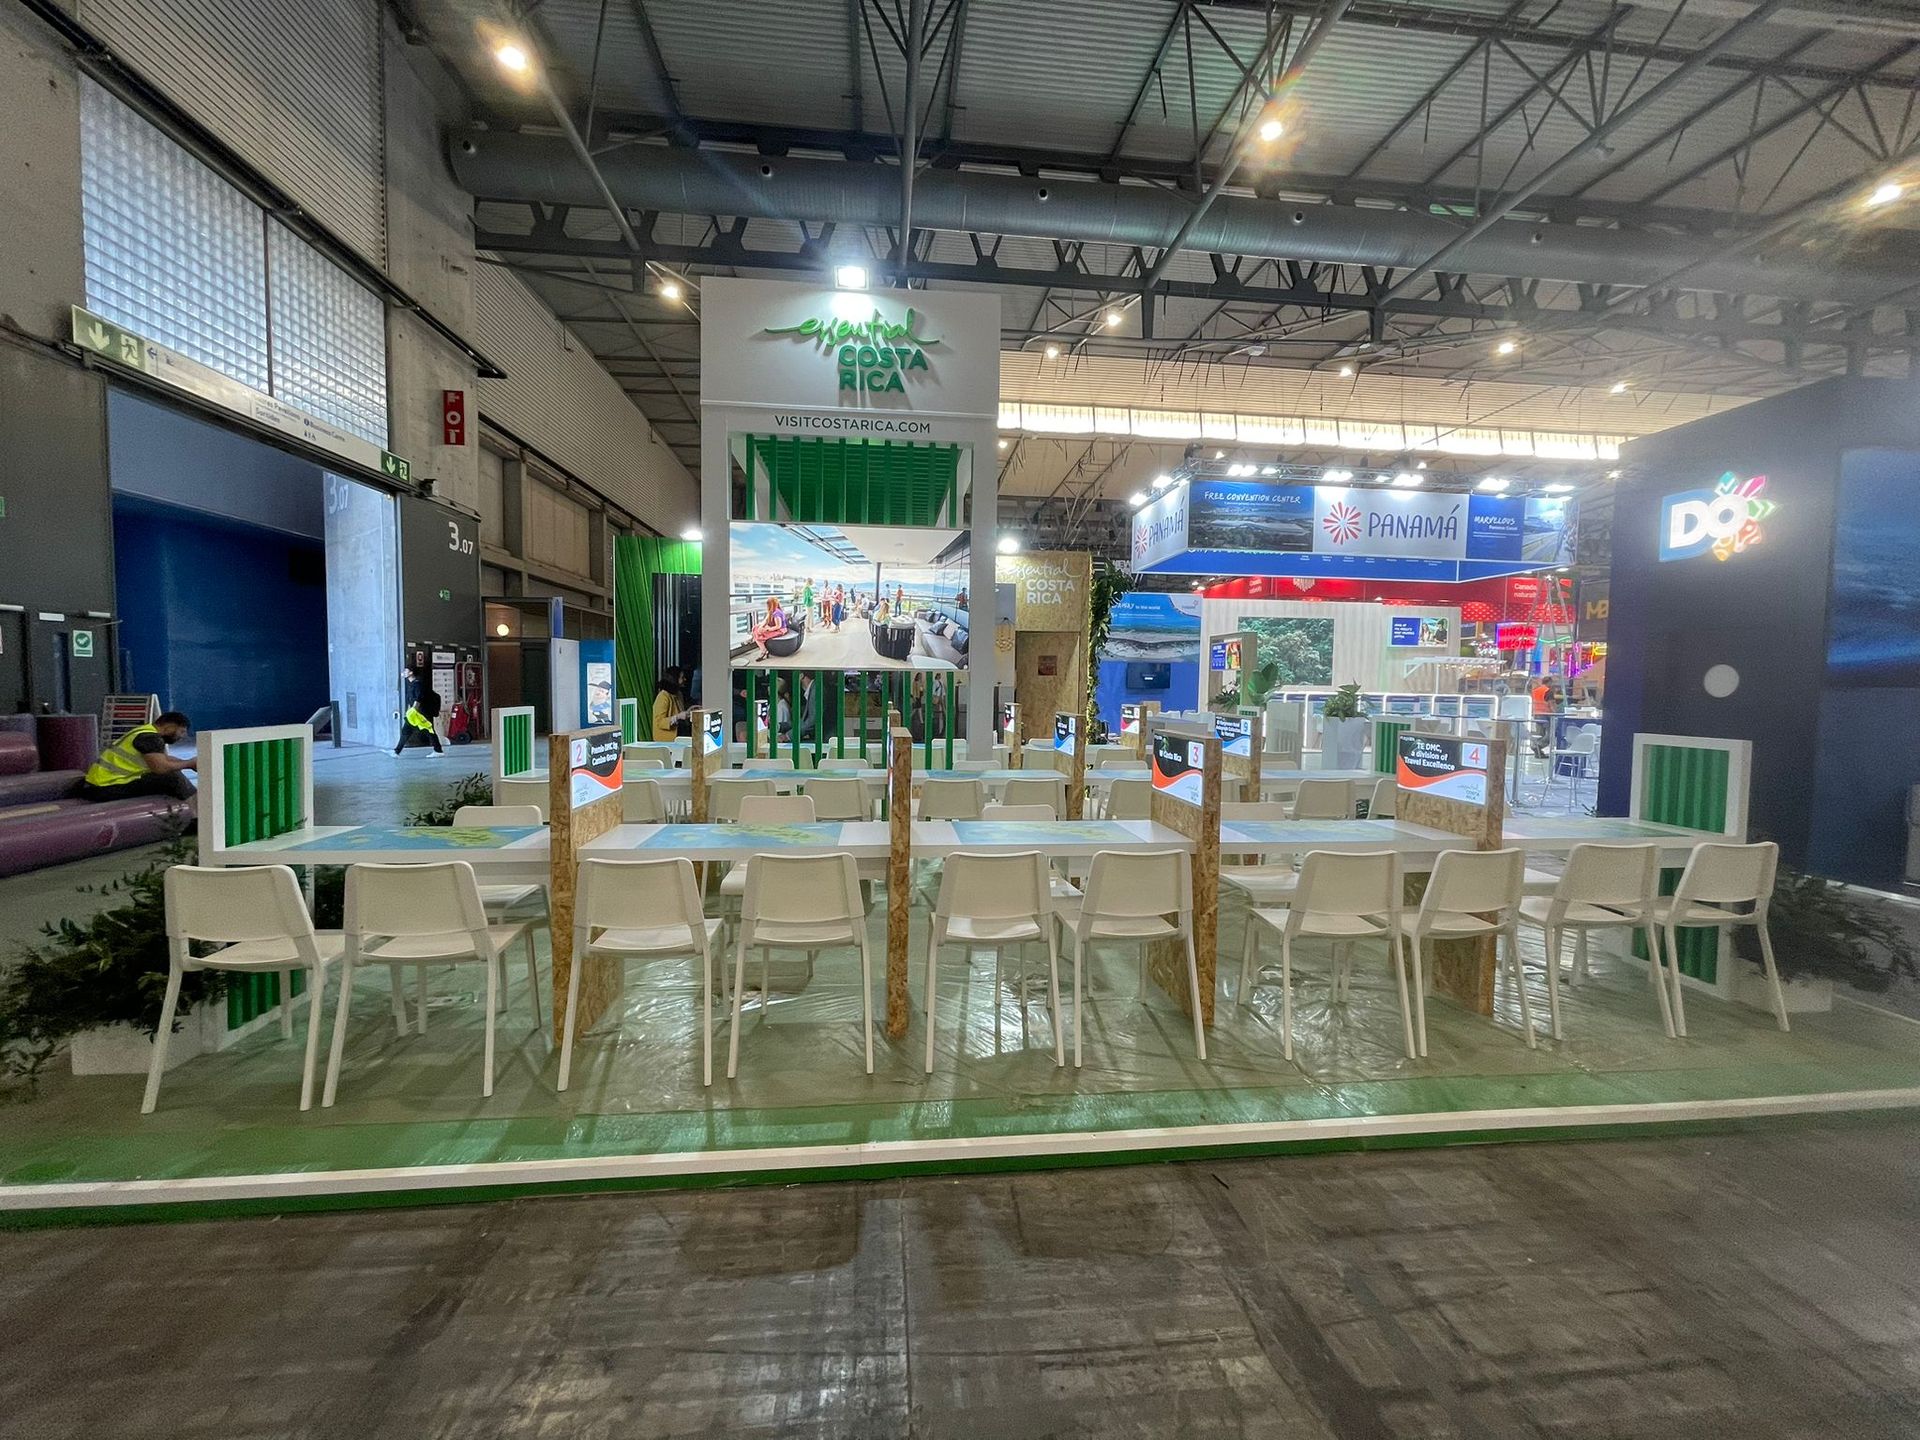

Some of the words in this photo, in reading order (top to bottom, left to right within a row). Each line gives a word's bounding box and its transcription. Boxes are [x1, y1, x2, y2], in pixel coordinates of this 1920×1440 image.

[765, 308, 940, 347] essential
[838, 344, 929, 371] COSTA
[839, 369, 905, 393] RICA
[775, 415, 931, 434] VISITCOSTARICA.COM
[1204, 491, 1225, 501] FREE
[1227, 492, 1271, 502] CONVENTION
[1272, 494, 1302, 504] CENTER
[1148, 495, 1185, 545] PANAMÁ
[1368, 503, 1460, 541] PANAMÁ
[448, 522, 474, 555] 3.07
[1026, 580, 1075, 592] COSTA
[1026, 592, 1063, 604] RICA
[1244, 721, 1249, 732] 9
[576, 744, 583, 762] 2
[1193, 746, 1199, 764] 3
[1416, 742, 1425, 750] TE
[1426, 743, 1442, 753] DMC,
[1416, 750, 1440, 760] division
[1440, 753, 1448, 761] of
[1469, 747, 1480, 764] 4
[1404, 756, 1422, 766] Travel
[1422, 758, 1456, 771] Excellence
